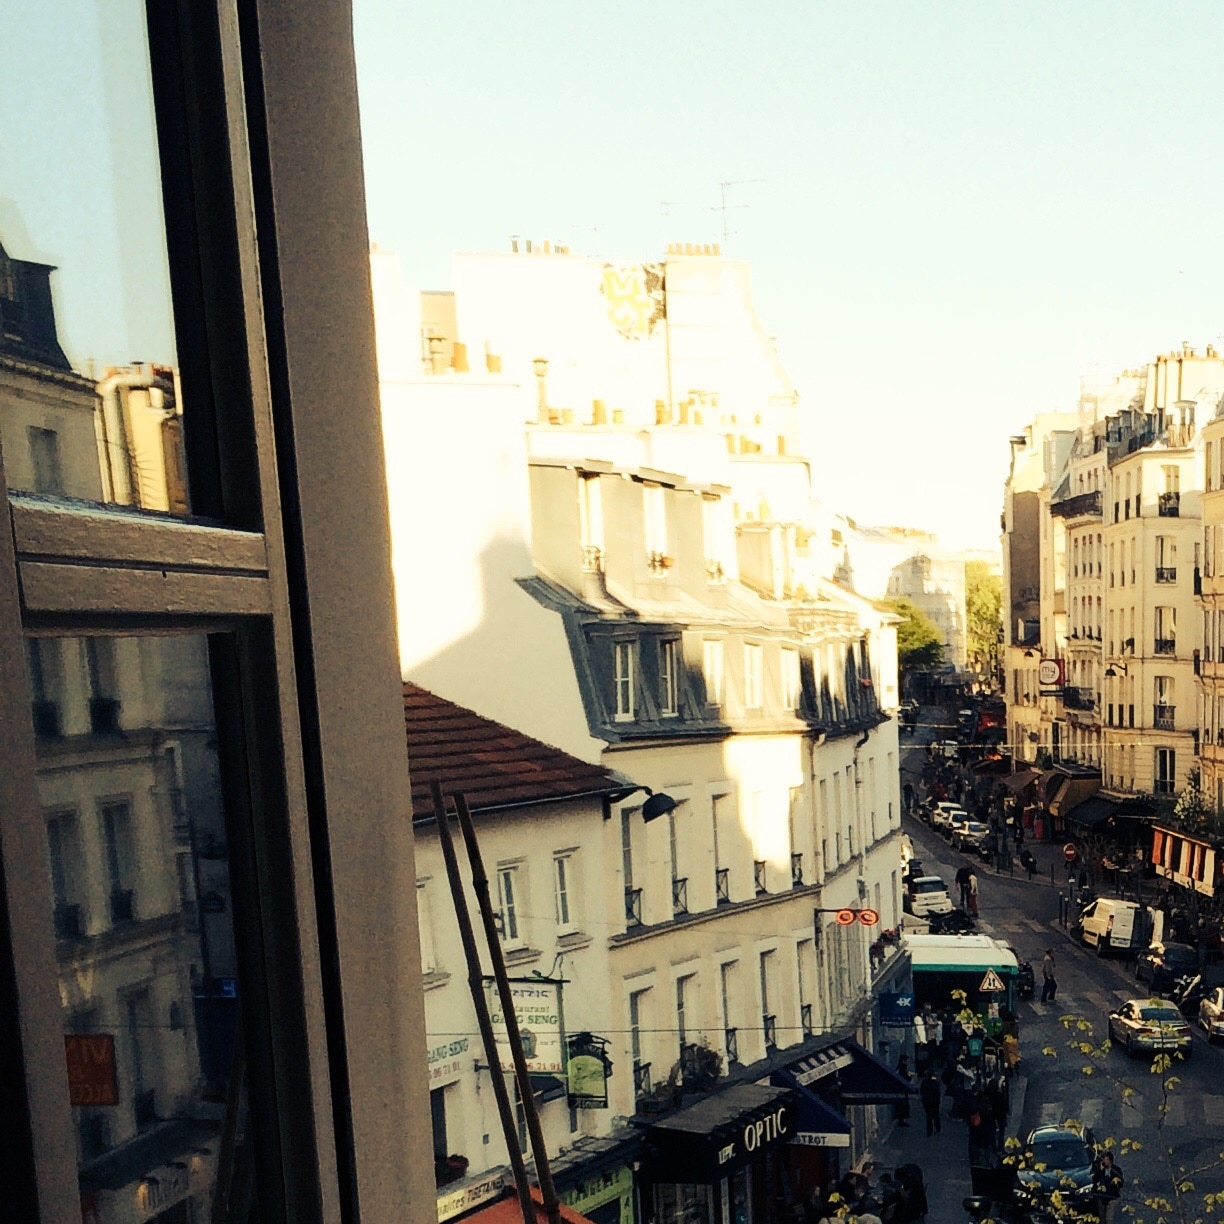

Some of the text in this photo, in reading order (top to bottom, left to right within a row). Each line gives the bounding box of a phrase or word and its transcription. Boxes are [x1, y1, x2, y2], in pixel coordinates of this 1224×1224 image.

[498, 1004, 550, 1012] Rtaurant
[491, 1014, 558, 1025] GAG SENG
[744, 1107, 787, 1151] OPTIC
[793, 1135, 827, 1145] STROT
